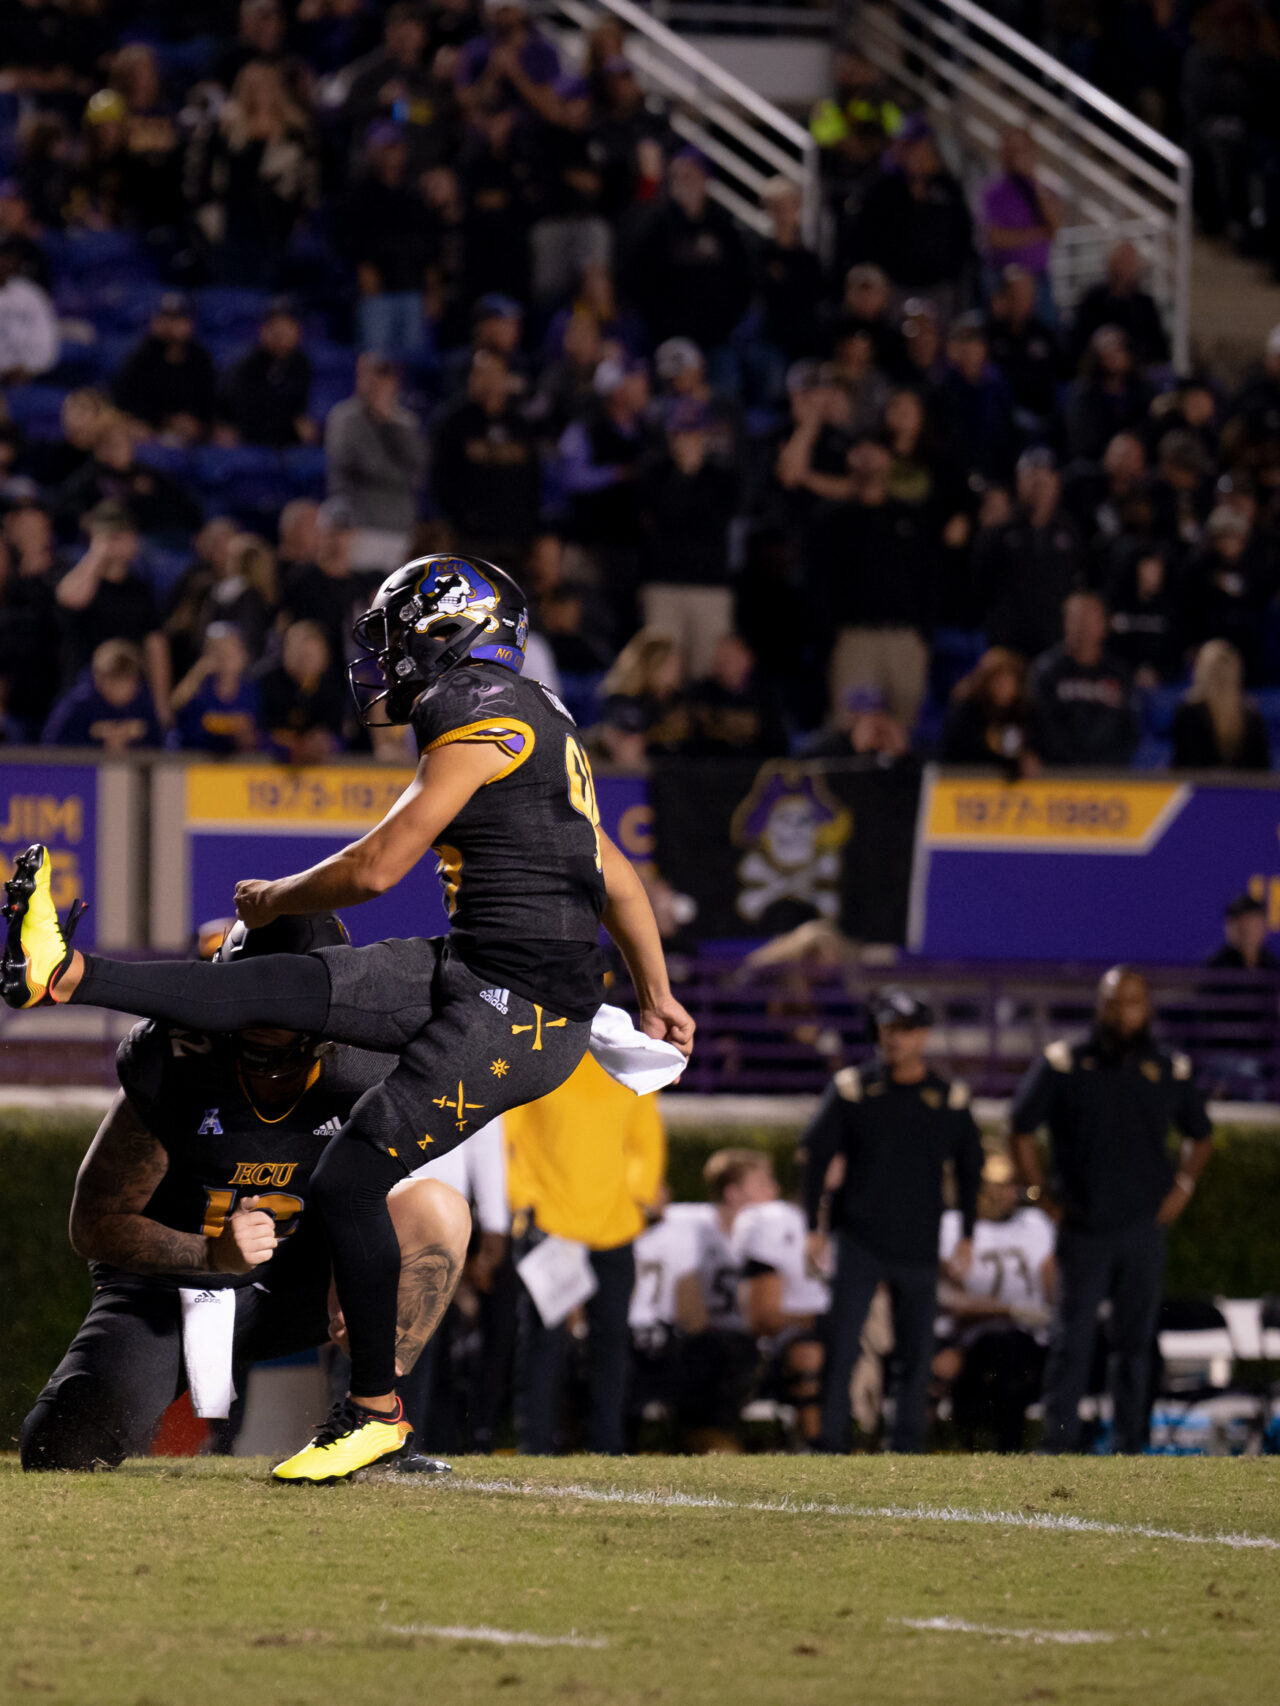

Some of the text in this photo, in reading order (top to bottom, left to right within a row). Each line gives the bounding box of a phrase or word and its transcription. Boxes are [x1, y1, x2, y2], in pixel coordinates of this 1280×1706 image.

[436, 563, 463, 573] ECU
[494, 647, 513, 662] NO
[479, 990, 509, 1015] adidas
[227, 1162, 299, 1187] ECU
